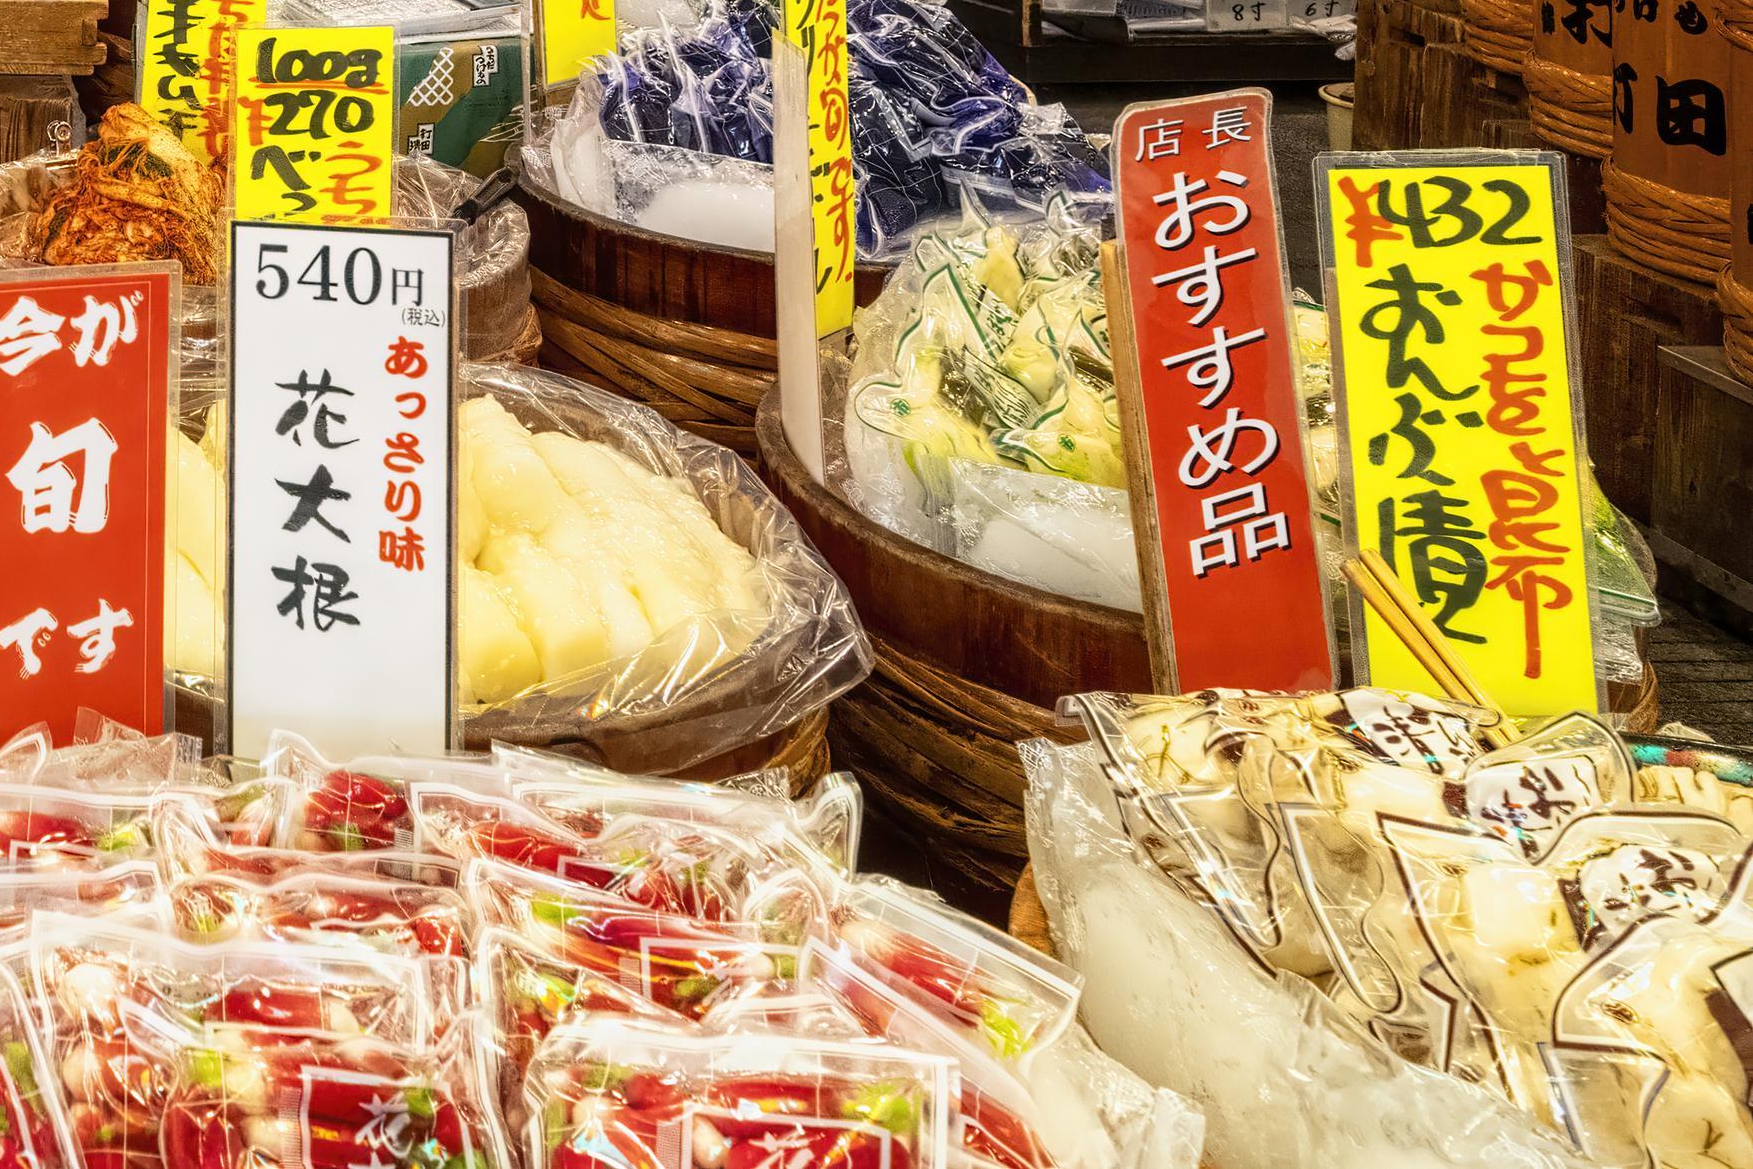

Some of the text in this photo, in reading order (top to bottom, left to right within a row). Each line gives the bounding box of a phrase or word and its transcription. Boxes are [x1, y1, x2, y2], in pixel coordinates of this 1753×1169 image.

[237, 88, 375, 147] ¥270
[1135, 105, 1253, 163] 店長
[1337, 175, 1544, 269] ¥432
[254, 242, 426, 308] 540円
[401, 306, 447, 329] (税込)
[1151, 167, 1292, 579] おすすめ品
[4, 416, 120, 535] 旬
[270, 367, 361, 632] 花大根
[378, 335, 429, 573] あっさり味
